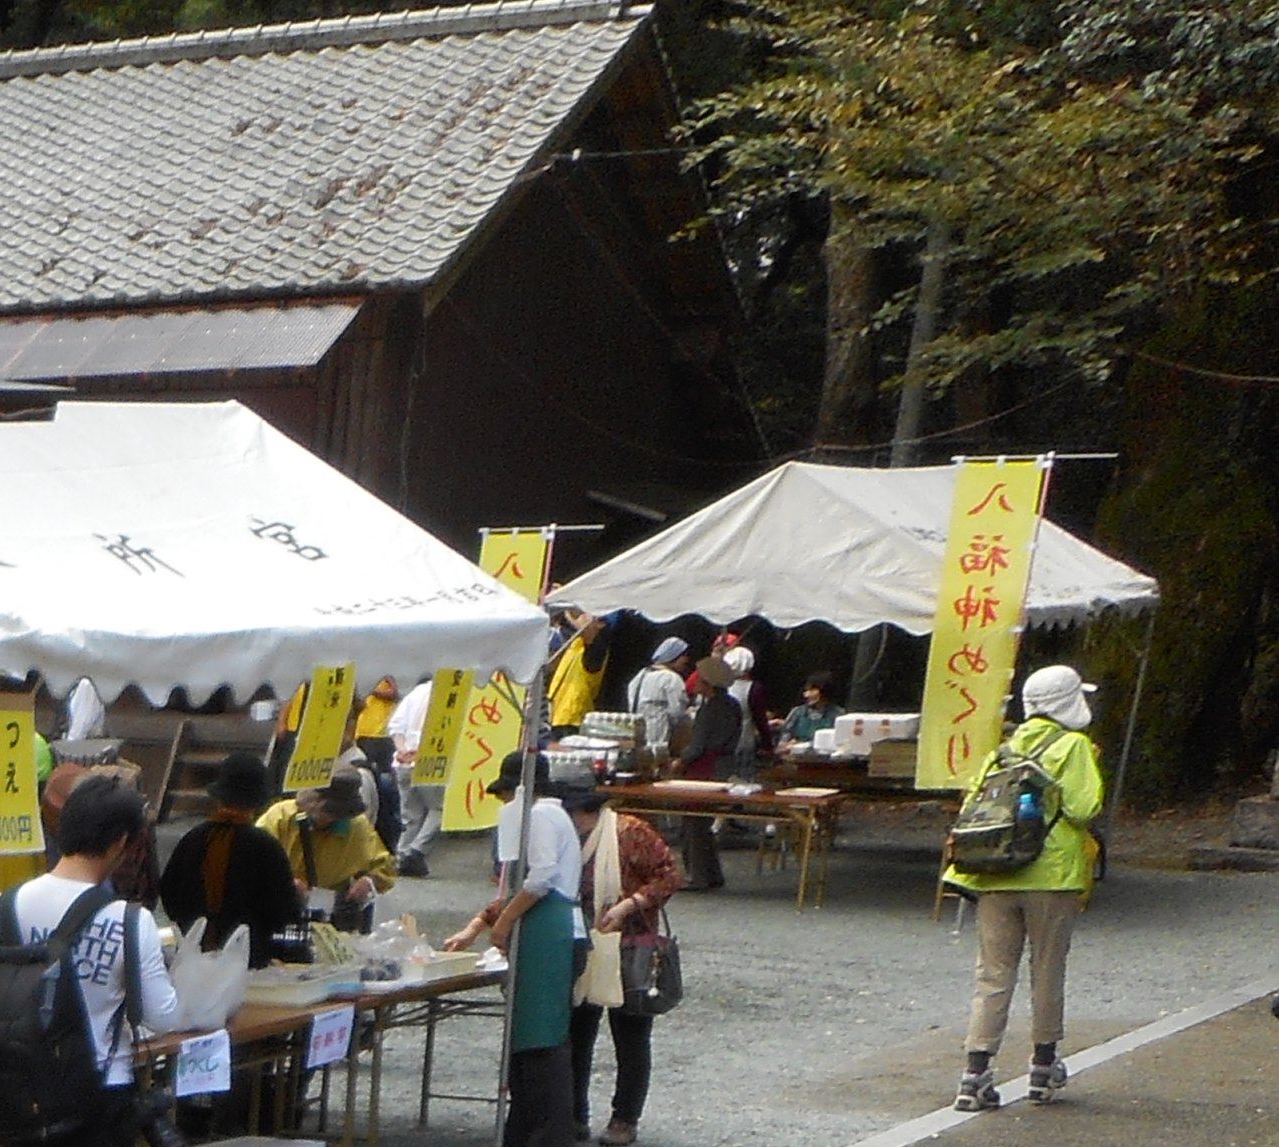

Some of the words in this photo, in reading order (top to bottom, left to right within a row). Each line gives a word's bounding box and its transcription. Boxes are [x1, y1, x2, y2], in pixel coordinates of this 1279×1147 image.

[5, 720, 20, 794] つえ
[87, 917, 124, 944] HE
[74, 958, 113, 986] CE
